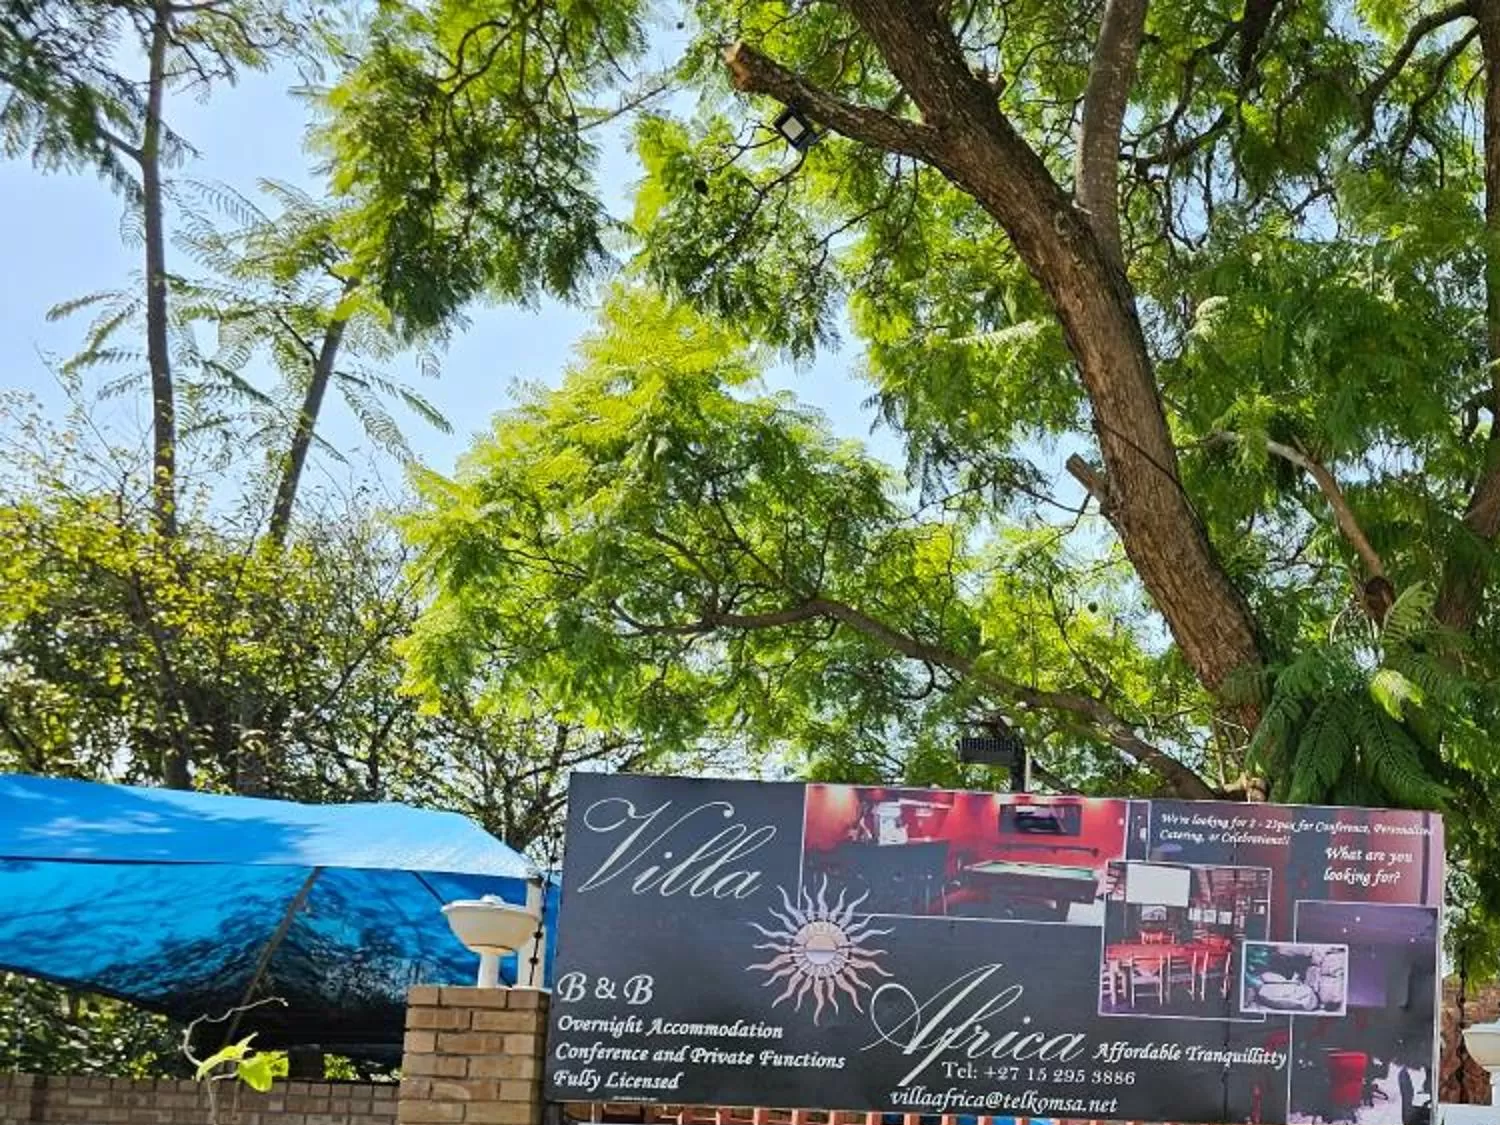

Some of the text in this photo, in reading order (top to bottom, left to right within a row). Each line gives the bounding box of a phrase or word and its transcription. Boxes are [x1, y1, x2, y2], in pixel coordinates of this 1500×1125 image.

[577, 797, 777, 900] Villa
[1324, 844, 1413, 866] What are you
[1323, 865, 1402, 887] looking for?
[557, 971, 654, 1005] B & B
[557, 1014, 784, 1040] Overnight Accommodation
[858, 963, 1086, 1087] Africa
[555, 1041, 847, 1069] Conference and Private Functions
[1091, 1041, 1182, 1064] Affordable
[553, 1068, 685, 1093] Fully Licensed
[941, 1060, 1137, 1087] Tel: +27 15 295 3886
[889, 1085, 1119, 1115] villaafrica@telkomsa.net
